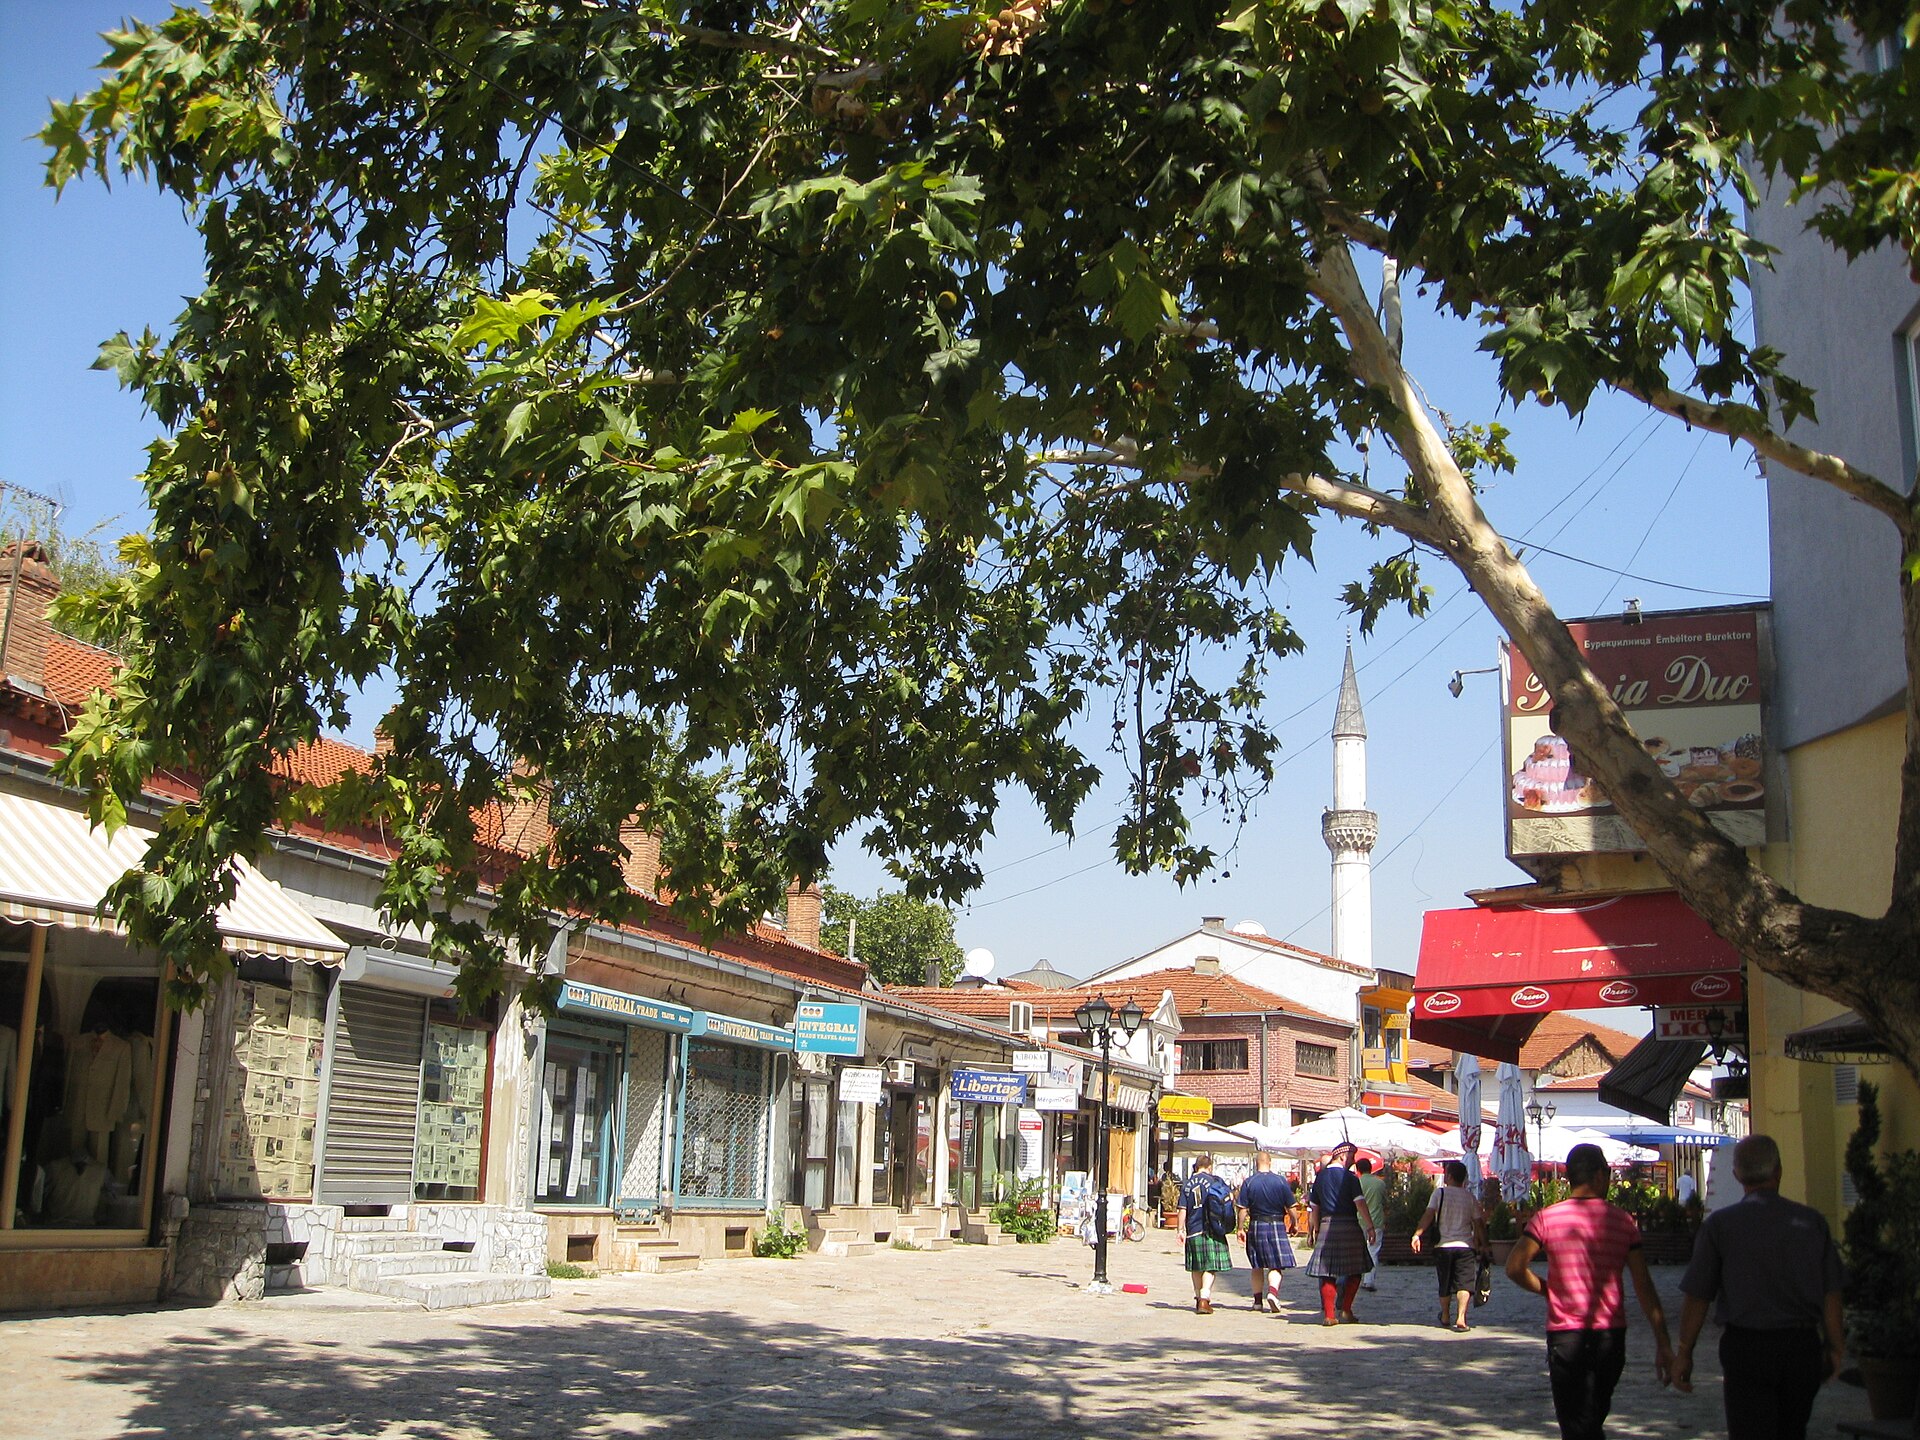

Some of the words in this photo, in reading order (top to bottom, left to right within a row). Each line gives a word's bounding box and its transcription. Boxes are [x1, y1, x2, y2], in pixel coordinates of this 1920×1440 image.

[1656, 654, 1752, 704] Duo
[589, 991, 636, 1015] INTEGRAL
[636, 1004, 658, 1019] TRADE
[723, 1021, 759, 1041] INTEGRAL
[798, 1020, 857, 1034] INTEGRAL
[959, 1078, 1021, 1094] Libertas
[1675, 1135, 1720, 1145] MARKET
[1191, 1184, 1203, 1209] 1
